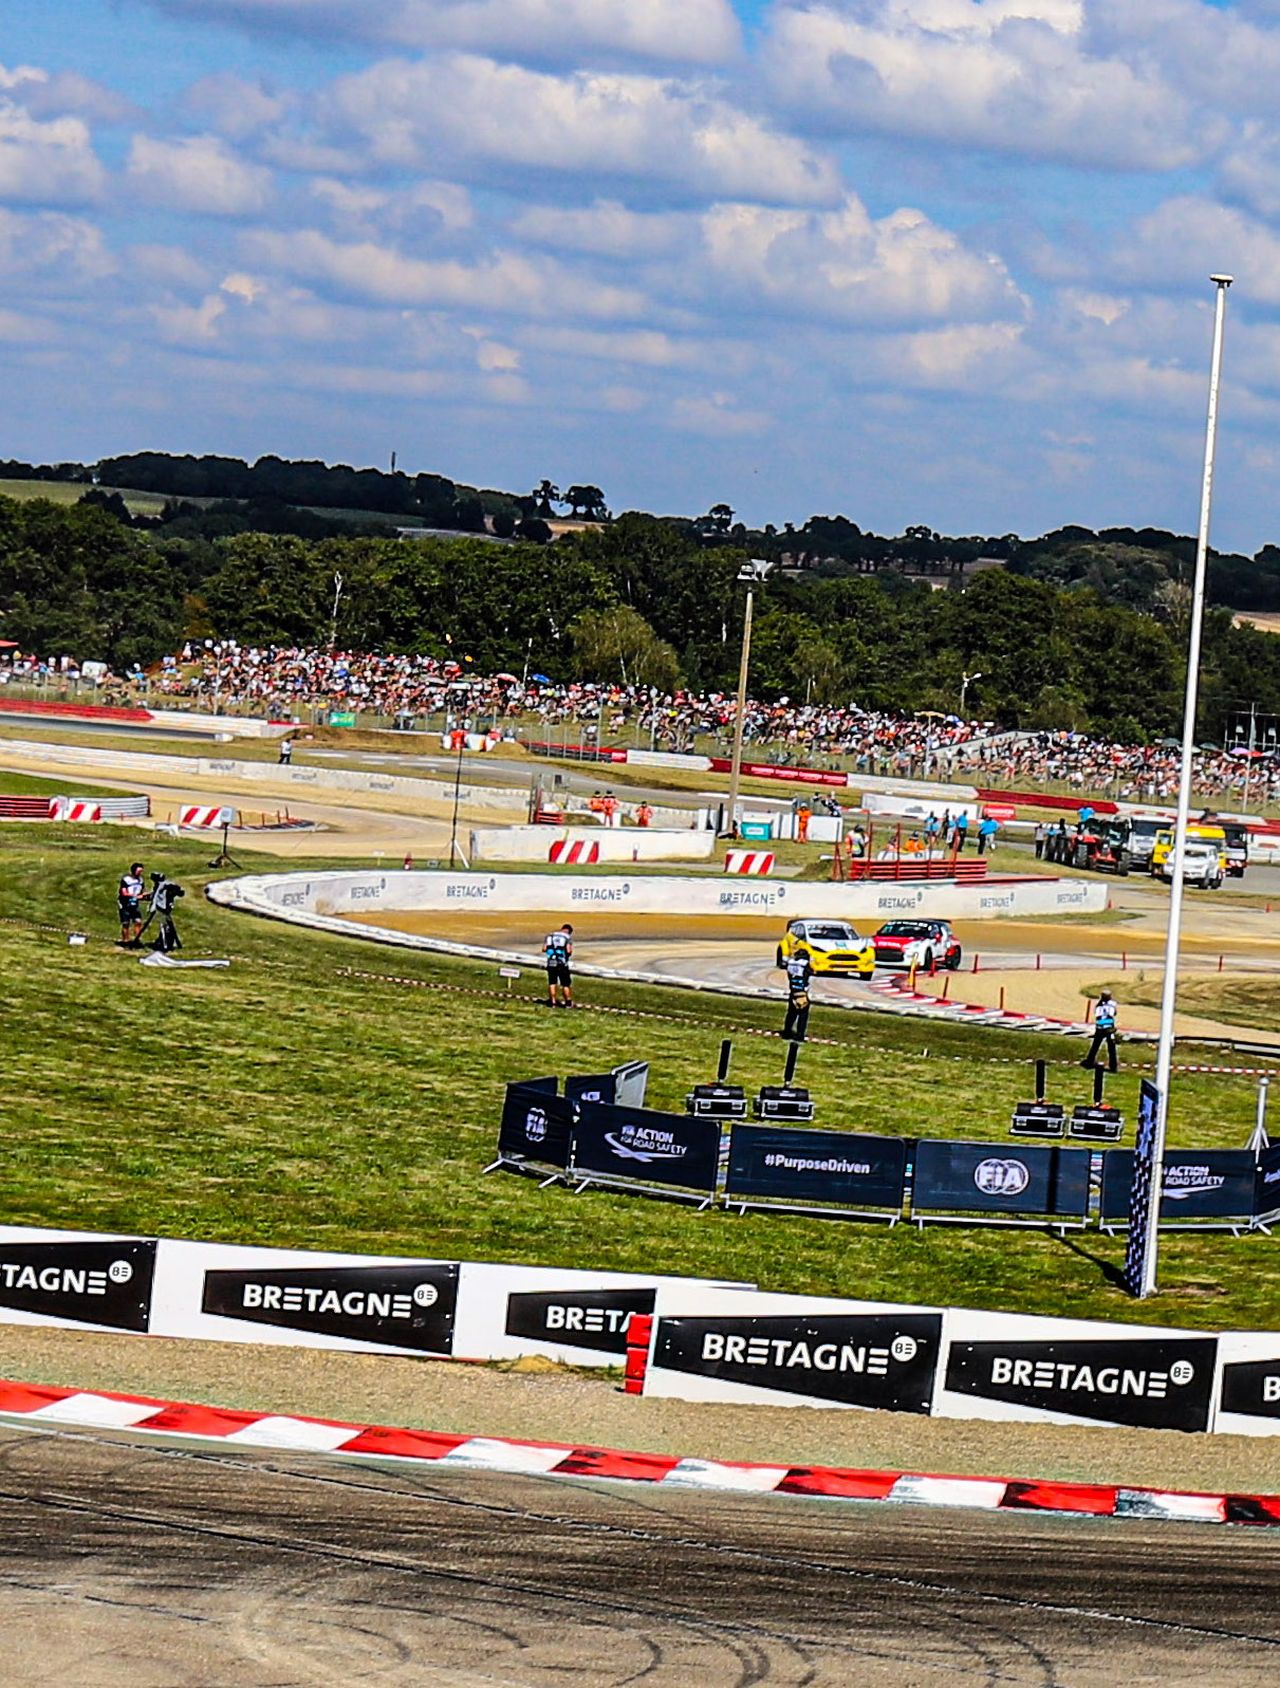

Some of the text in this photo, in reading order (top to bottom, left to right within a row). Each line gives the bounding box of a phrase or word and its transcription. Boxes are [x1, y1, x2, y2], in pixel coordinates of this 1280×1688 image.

[571, 888, 622, 901] BRETAGNE
[720, 892, 776, 905] BRETAGNE
[636, 1127, 674, 1144] ACTION
[632, 1138, 655, 1149] ROAD
[656, 1142, 688, 1155] SAFETY
[764, 1153, 871, 1175] #PurposeDriven
[1168, 1165, 1210, 1176] ACTION
[1165, 1175, 1225, 1186] ROAD SAFETY
[0, 1262, 108, 1295] TAGNE
[243, 1283, 412, 1319] BRETAGNE
[701, 1333, 890, 1375] BRETAGNE
[991, 1357, 1168, 1399] BRETAGNE
